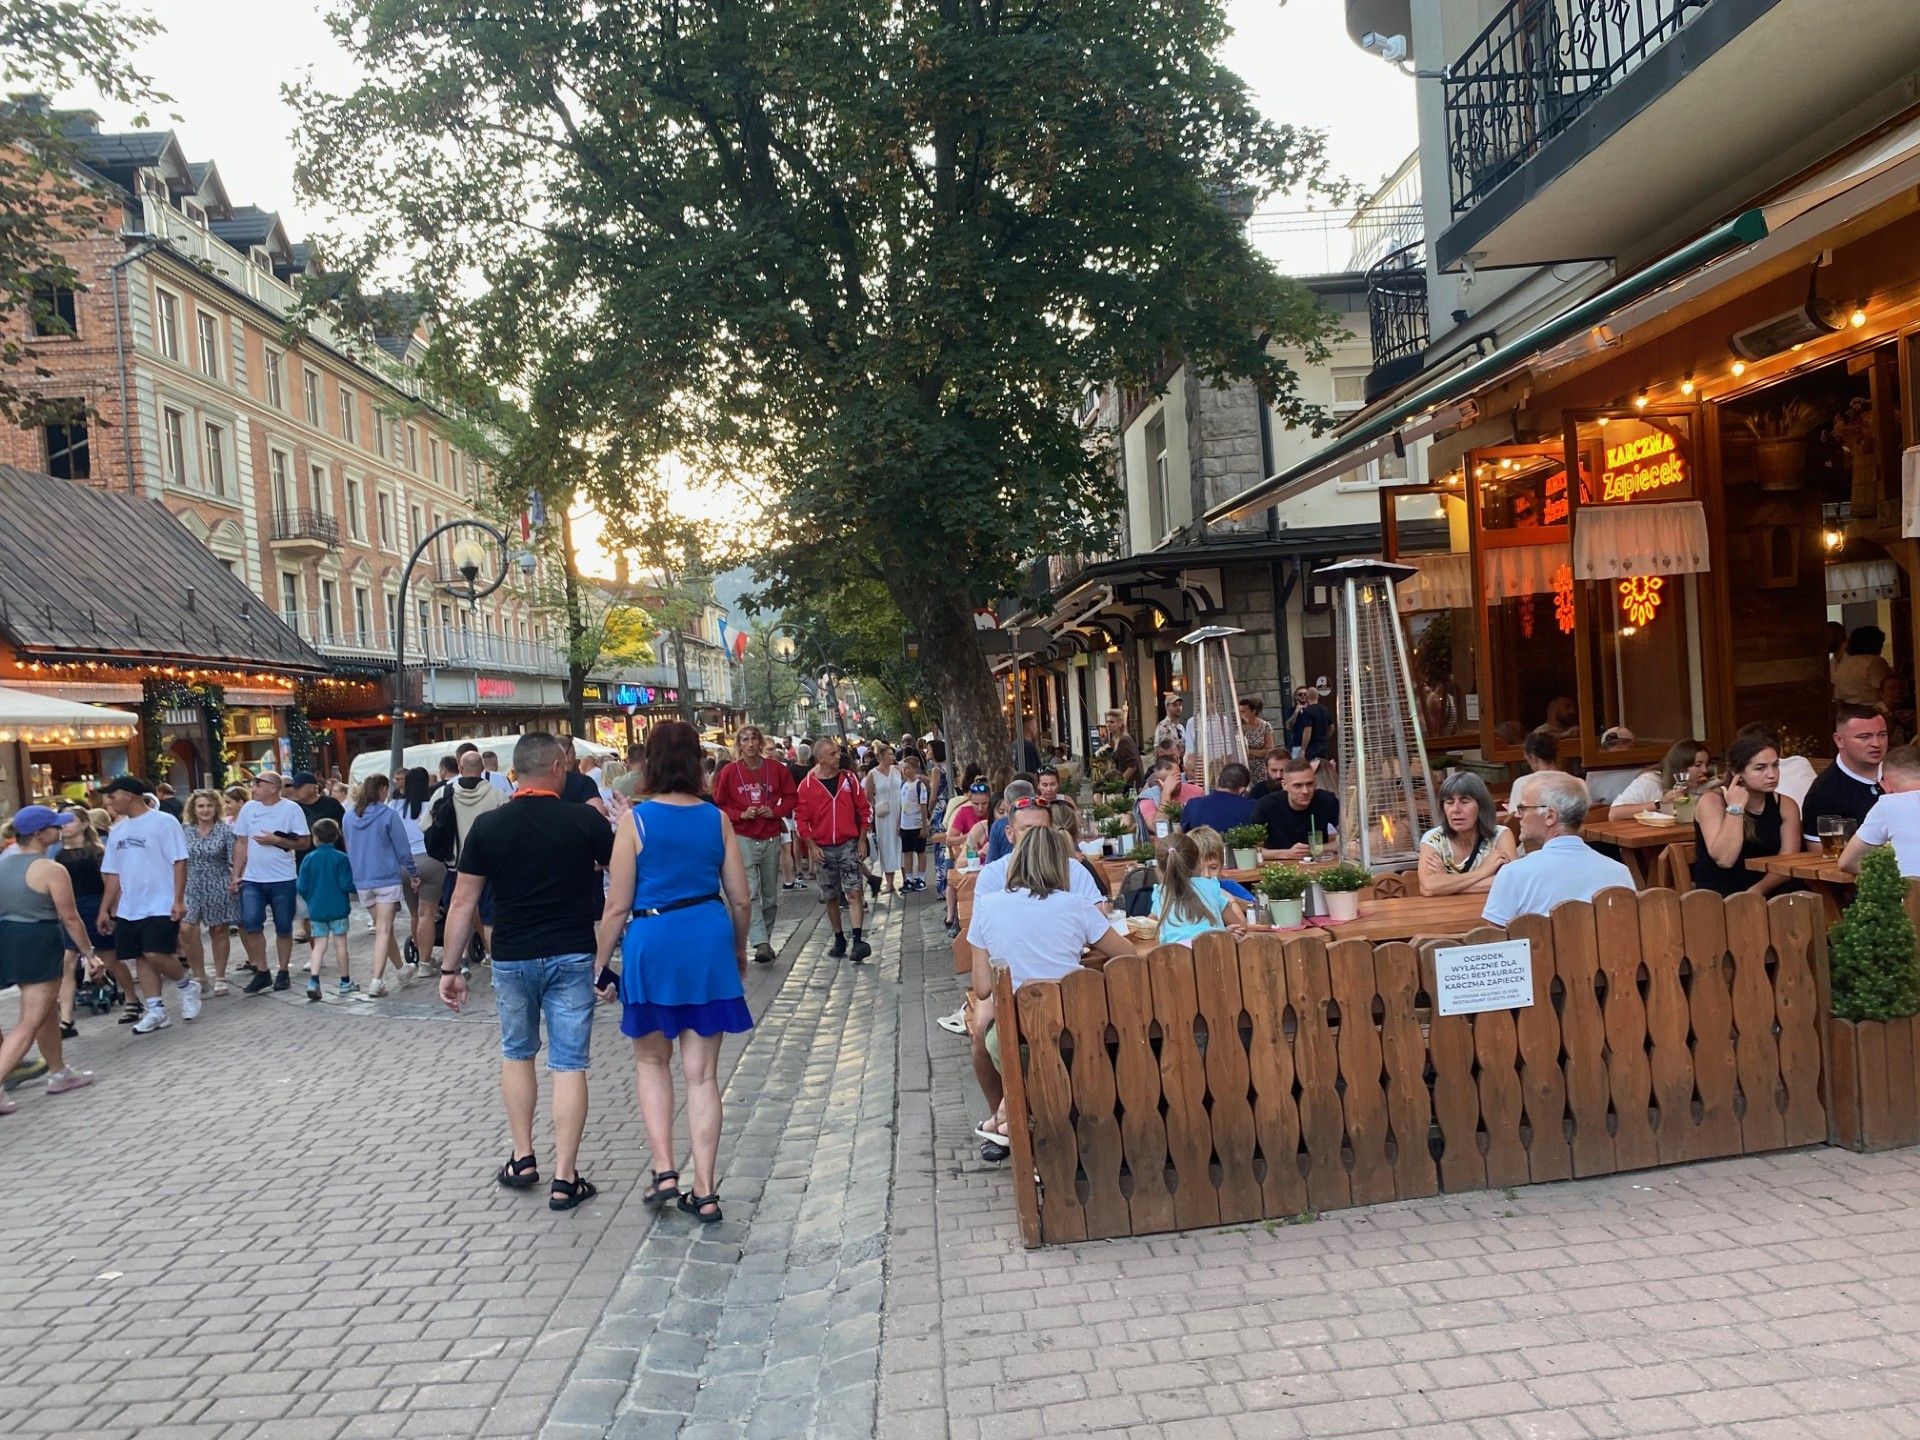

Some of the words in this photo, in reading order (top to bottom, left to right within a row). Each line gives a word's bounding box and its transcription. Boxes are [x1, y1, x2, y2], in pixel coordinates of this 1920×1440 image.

[1607, 432, 1675, 469] KARCZMA
[1602, 453, 1683, 502] Zapiecek
[1463, 952, 1503, 962] OGRÓDEK
[1451, 961, 1498, 972] WYŁĄCZNIE
[1501, 959, 1517, 967] DLA
[1444, 972, 1469, 981] GOŚCI
[1471, 967, 1524, 978] RESTAURACJI
[1445, 980, 1485, 989] KARCZMA
[1487, 976, 1525, 985] ZAPIECEK
